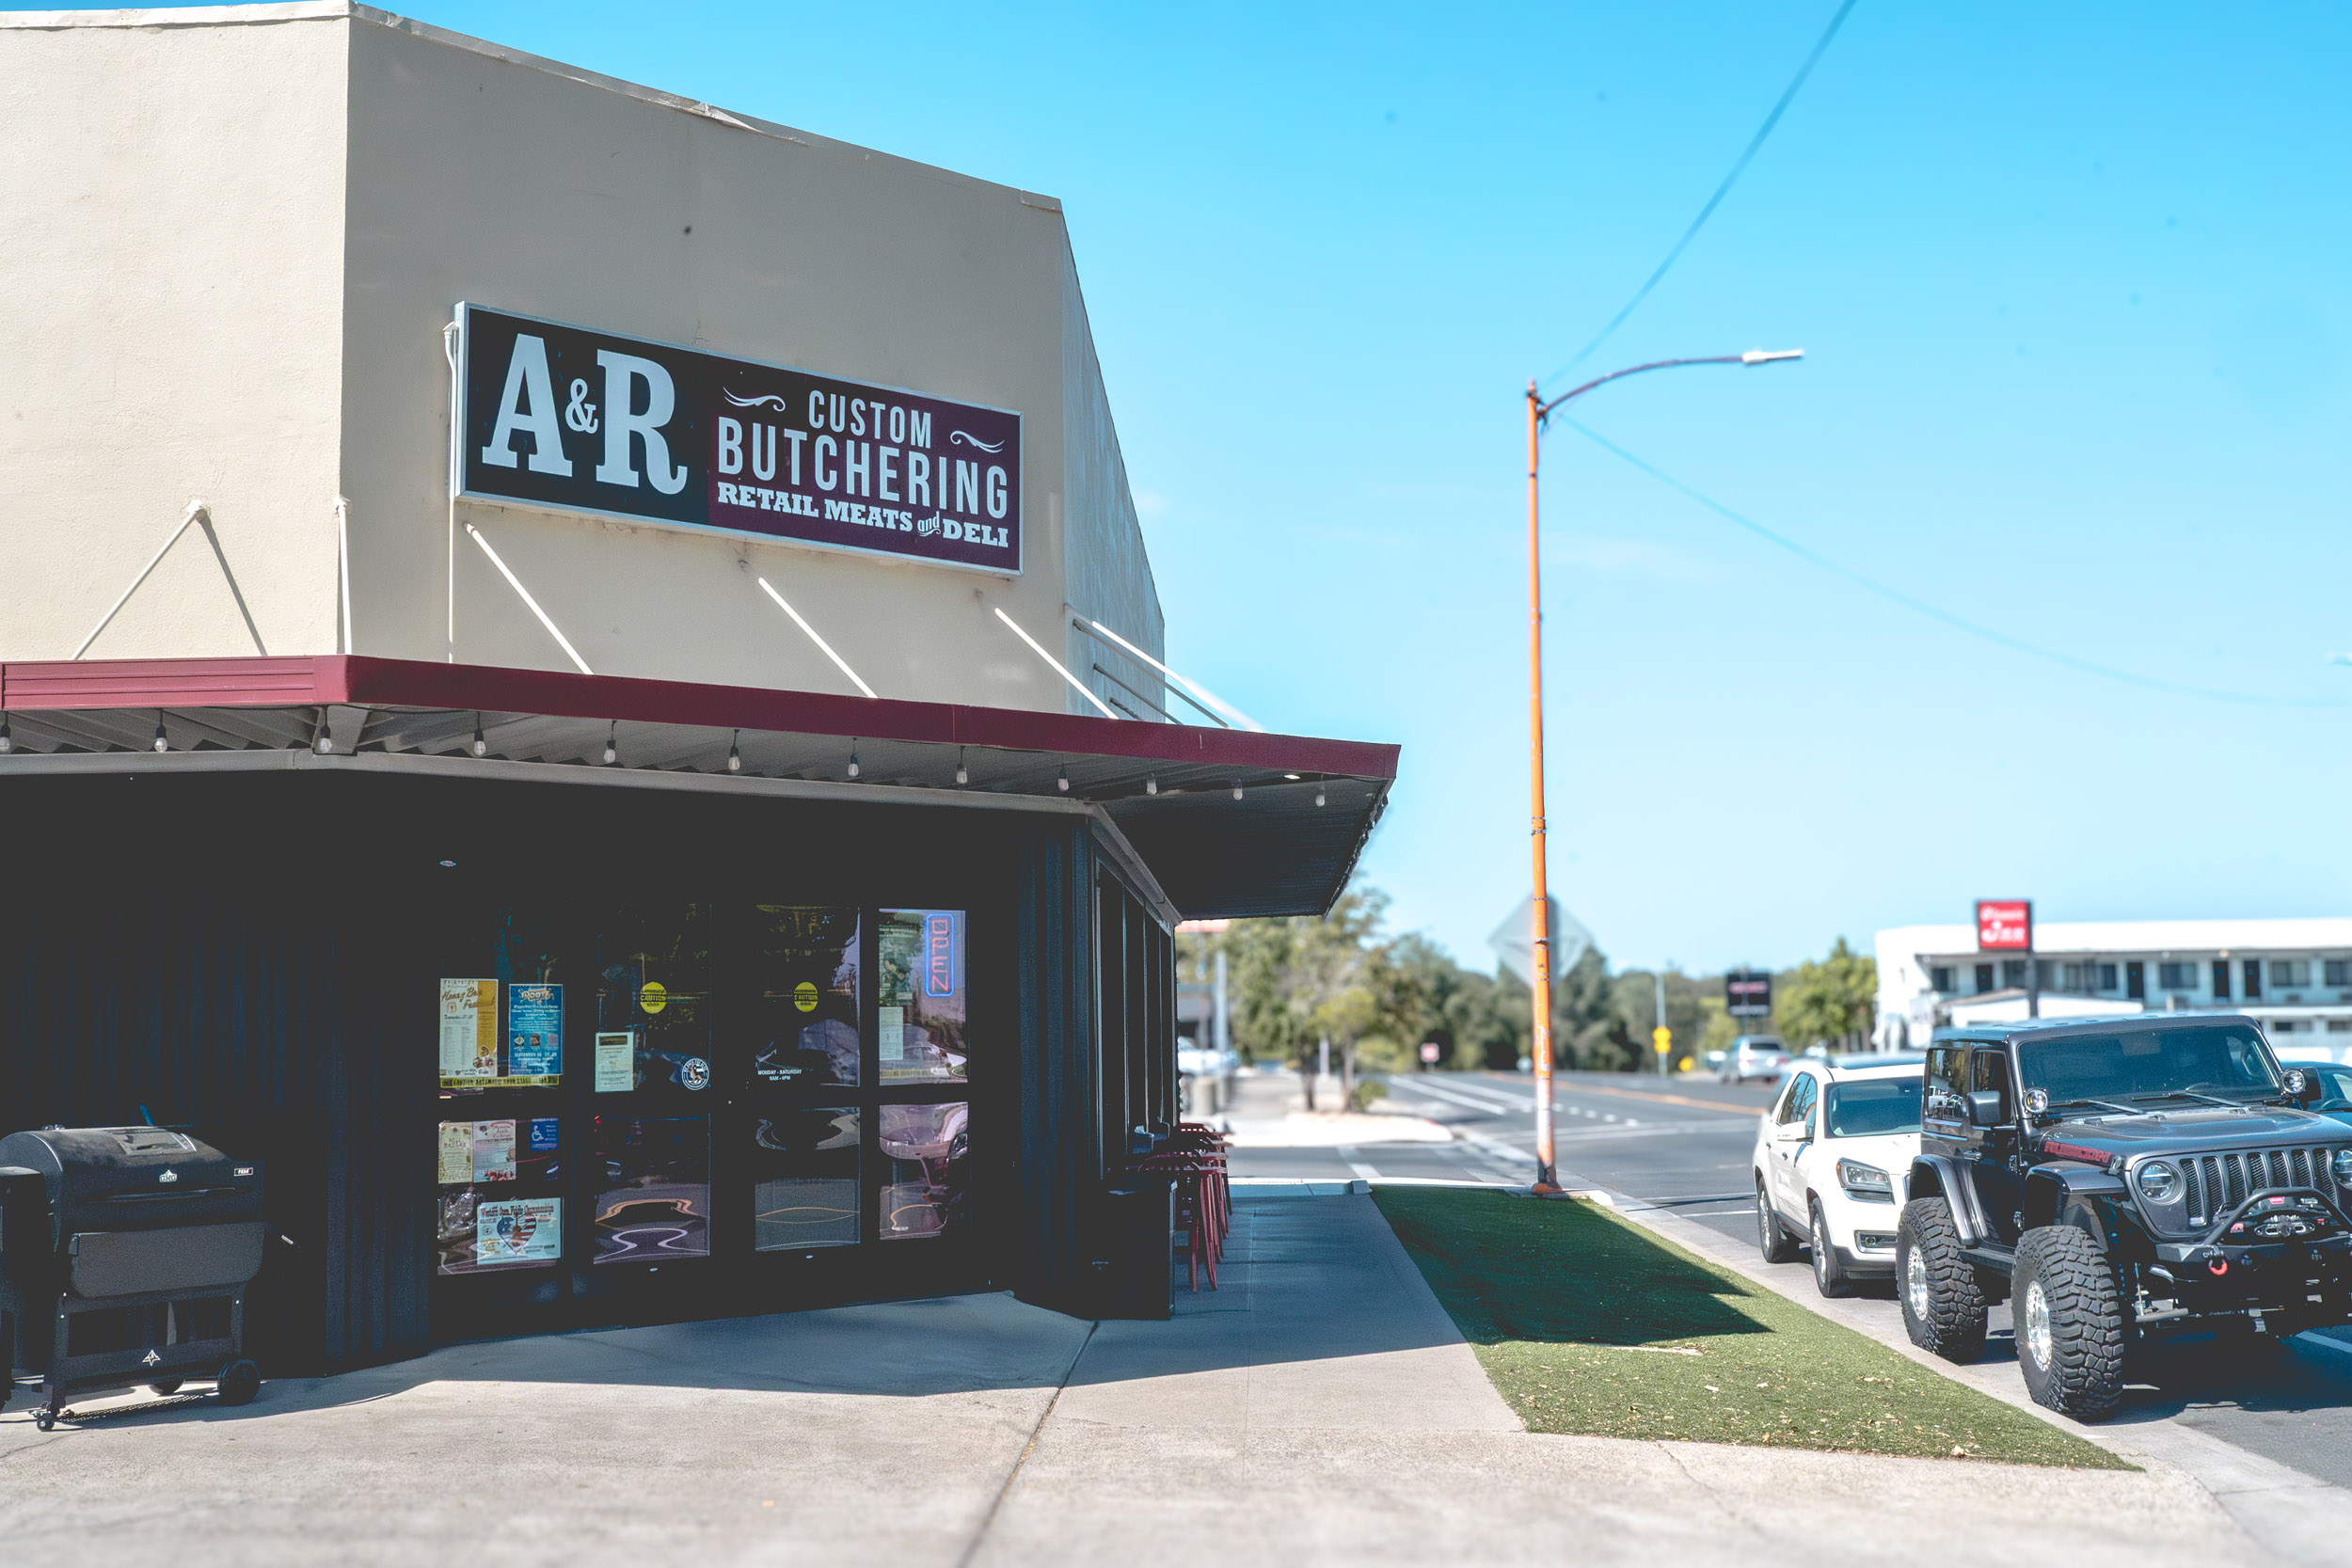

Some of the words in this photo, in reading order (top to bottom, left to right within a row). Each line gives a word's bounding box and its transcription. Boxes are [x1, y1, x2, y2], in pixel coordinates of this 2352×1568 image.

[482, 333, 687, 495] A&R
[808, 389, 931, 449] CUSTOM
[718, 416, 1008, 519] BUTCHERING
[718, 481, 818, 518] RETAIL
[824, 499, 913, 532] MEATS
[917, 511, 940, 536] and
[943, 519, 1009, 548] DELI
[931, 919, 949, 992] OPEN
